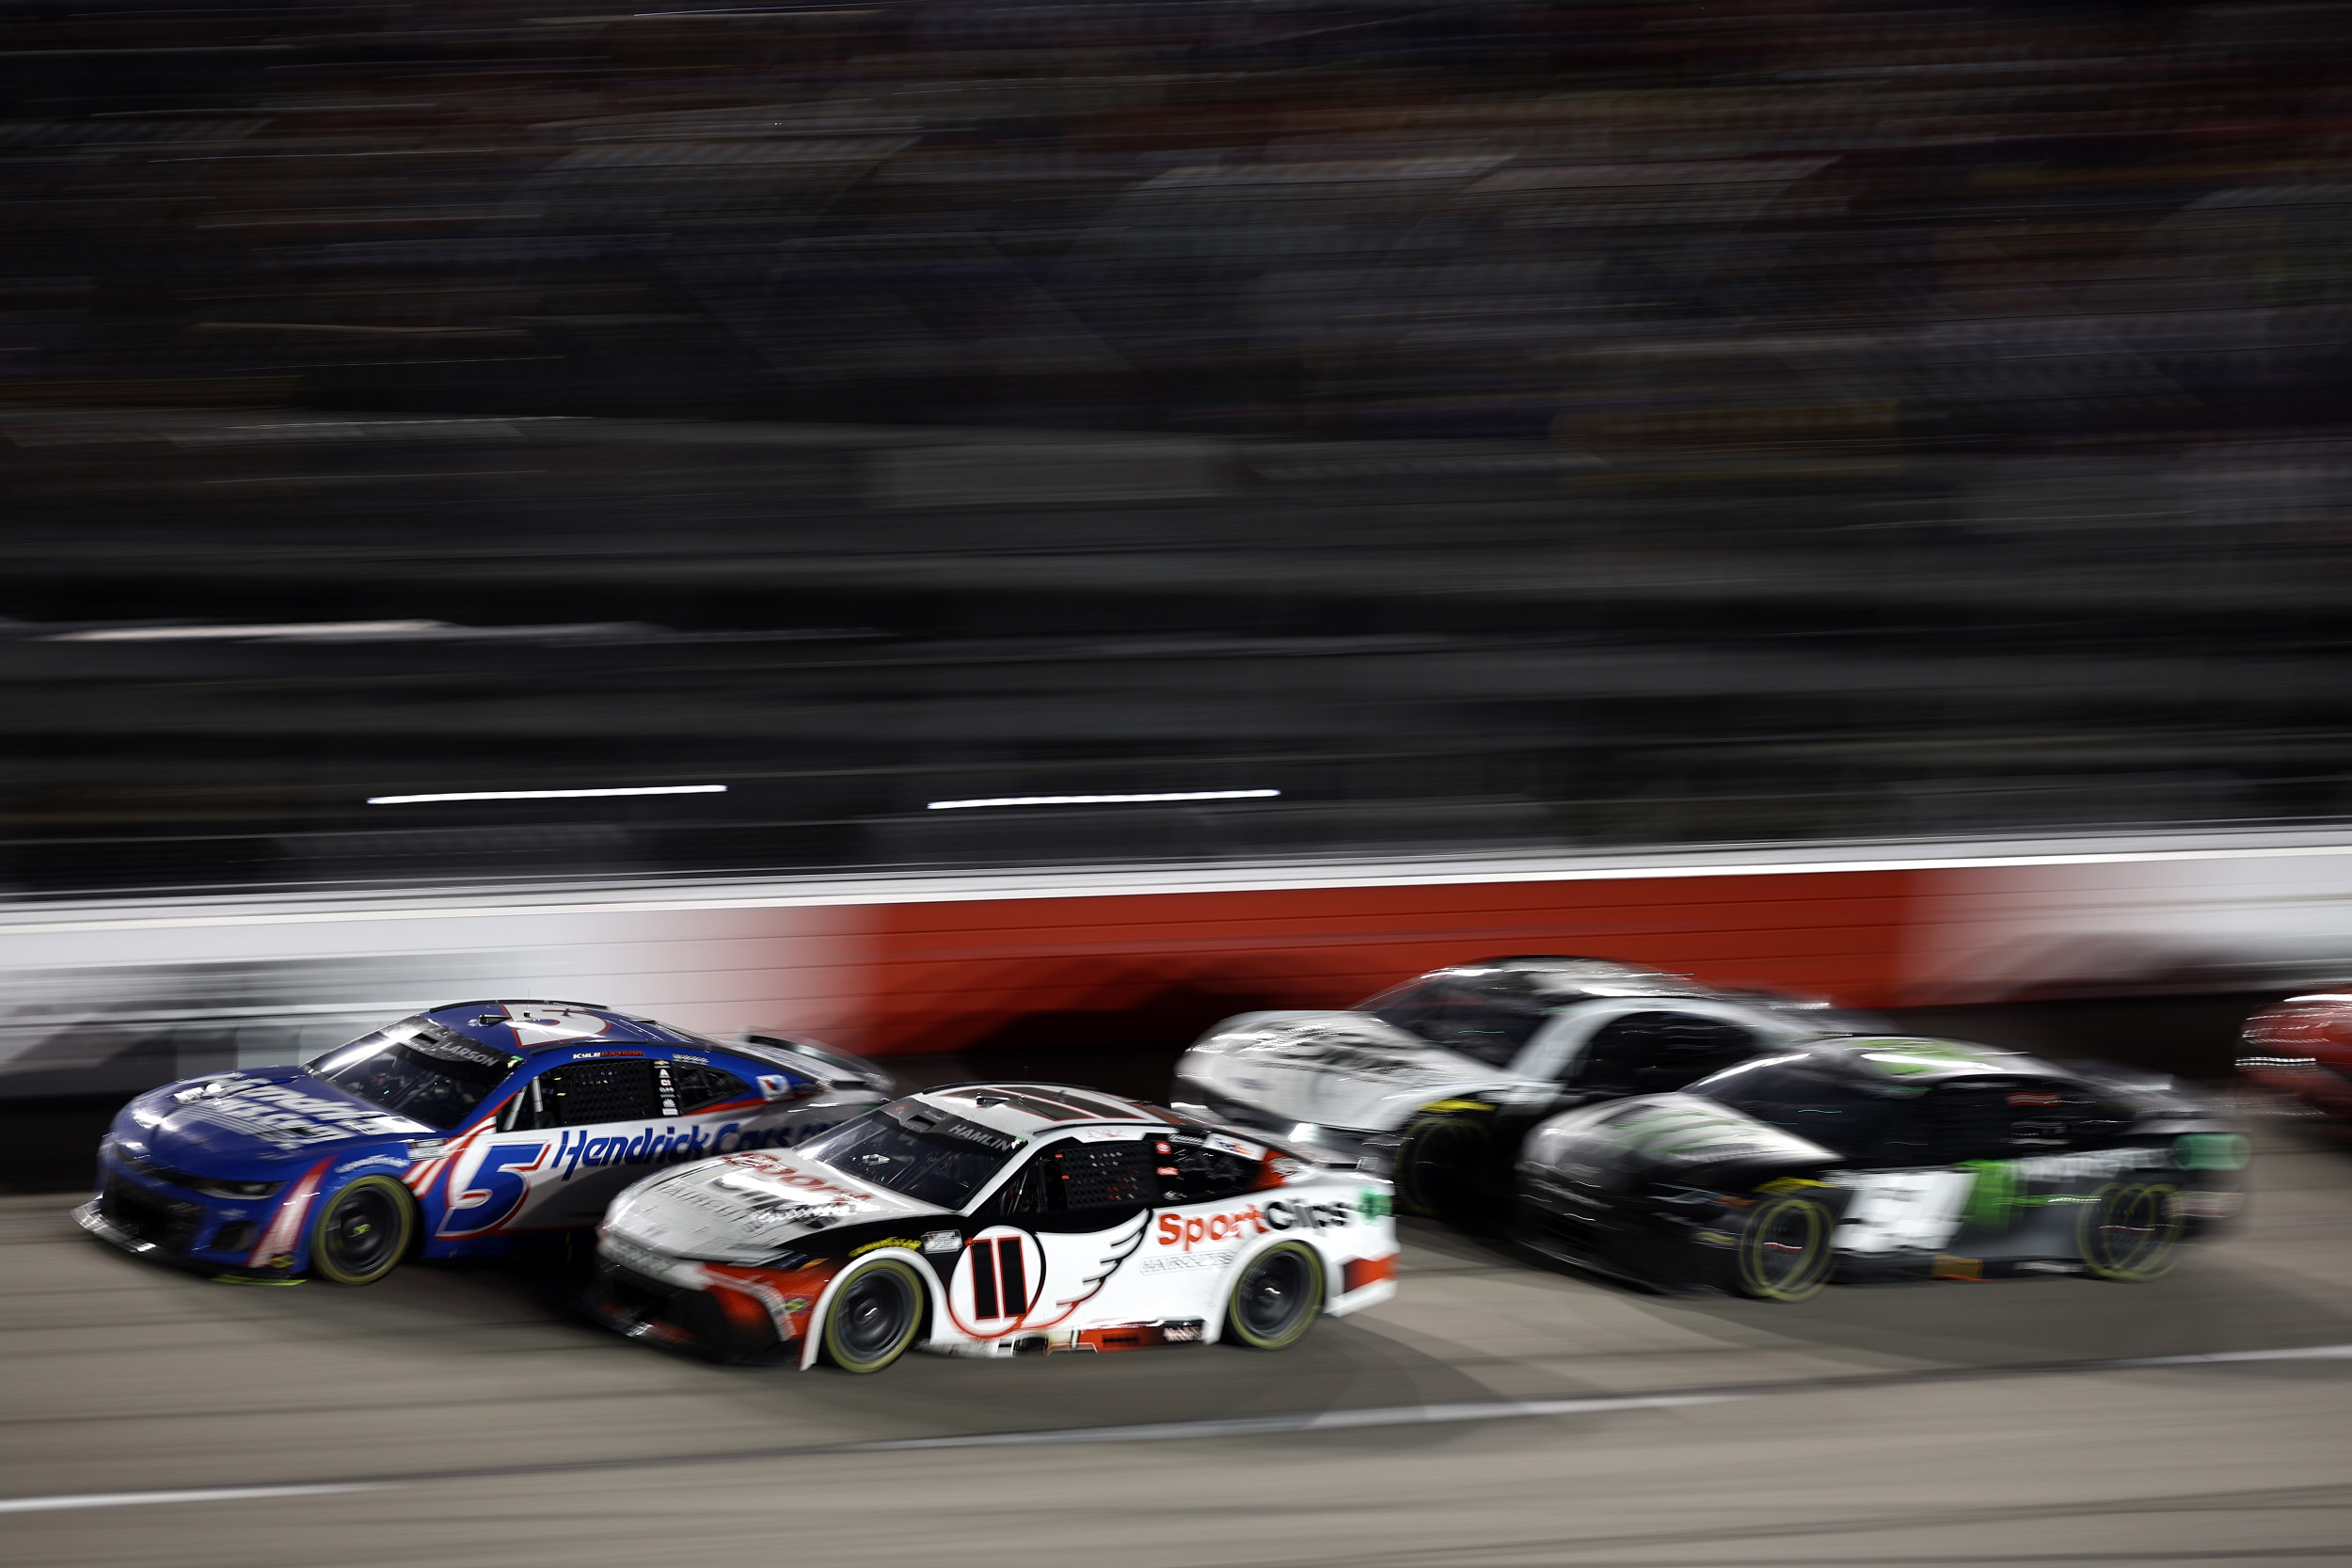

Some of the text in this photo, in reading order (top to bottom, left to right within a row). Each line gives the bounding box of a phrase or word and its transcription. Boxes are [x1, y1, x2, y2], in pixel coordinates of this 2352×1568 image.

[440, 1042, 501, 1068] LARSON
[947, 1124, 1012, 1152] HAMLIN
[436, 1138, 553, 1241] 5
[968, 1235, 1029, 1322] 11
